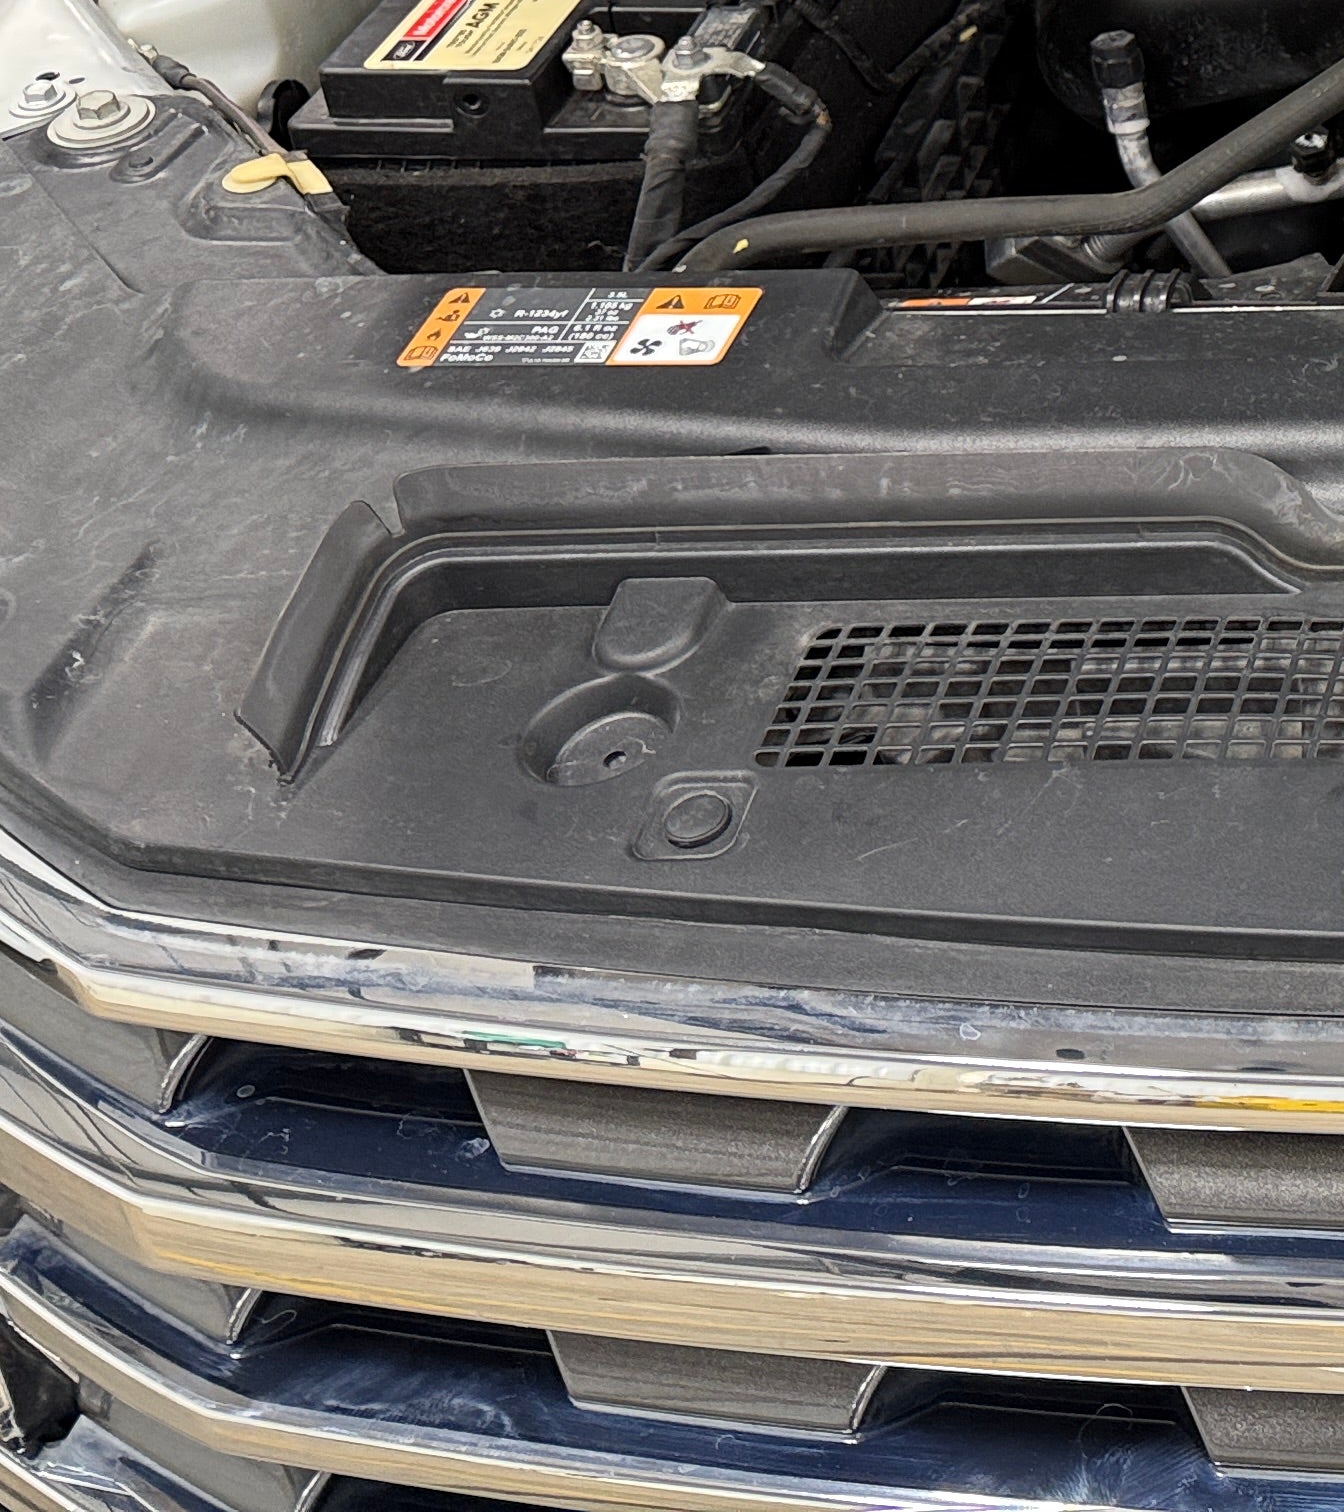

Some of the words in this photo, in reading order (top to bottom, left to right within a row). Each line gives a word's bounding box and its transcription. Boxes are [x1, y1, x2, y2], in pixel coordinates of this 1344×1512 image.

[465, 2, 500, 29] AGM
[513, 309, 569, 319] R-1234yf
[440, 353, 494, 362] FoMoCo
